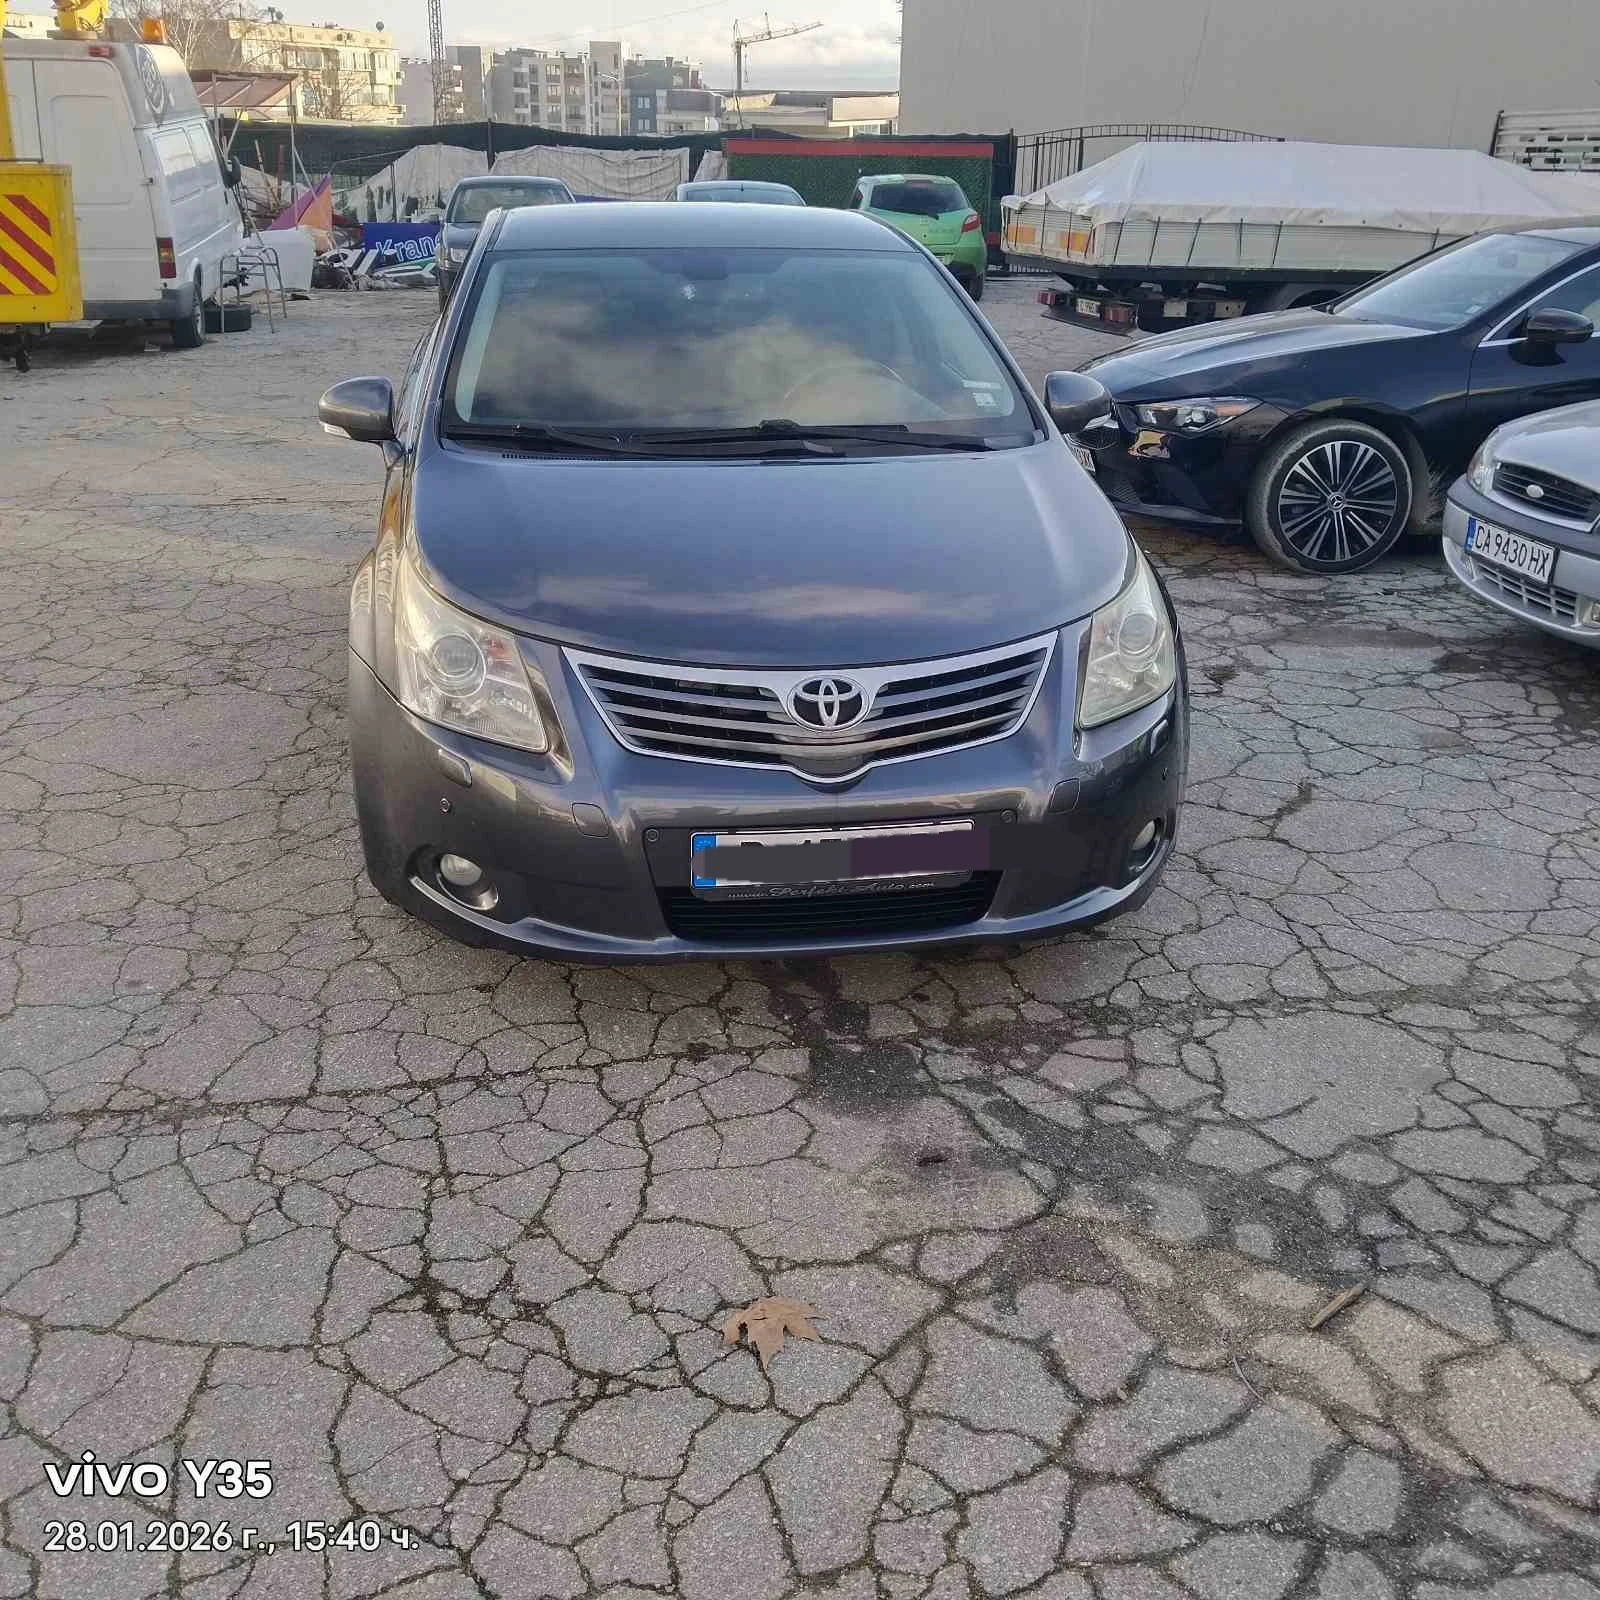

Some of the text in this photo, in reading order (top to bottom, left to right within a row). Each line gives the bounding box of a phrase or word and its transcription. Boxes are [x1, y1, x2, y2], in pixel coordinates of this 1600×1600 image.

[1476, 526, 1549, 577] CA 9430 HX
